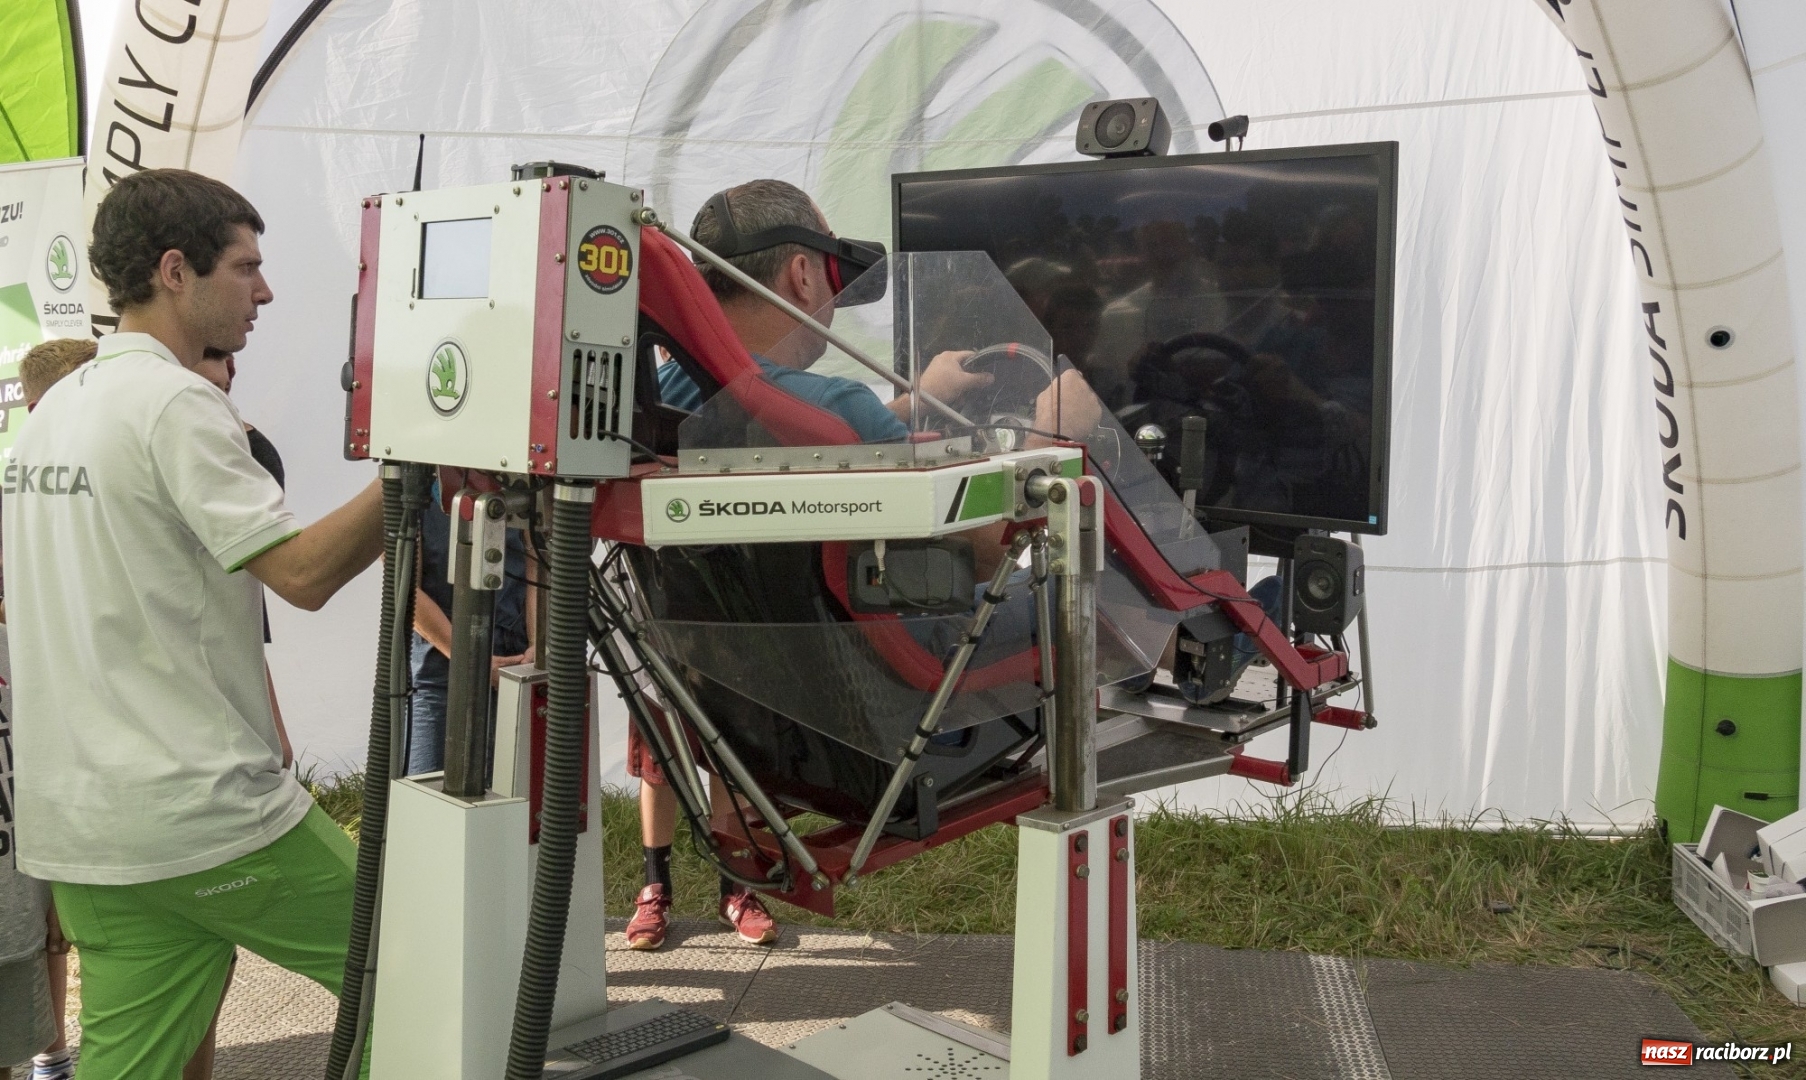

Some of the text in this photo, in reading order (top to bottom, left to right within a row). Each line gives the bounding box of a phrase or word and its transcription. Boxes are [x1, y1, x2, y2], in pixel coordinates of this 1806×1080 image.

[0, 201, 23, 223] ZU!
[580, 243, 630, 277] 301
[44, 301, 85, 315] ŠKODA
[699, 500, 882, 516] ŠKODA Motorsport
